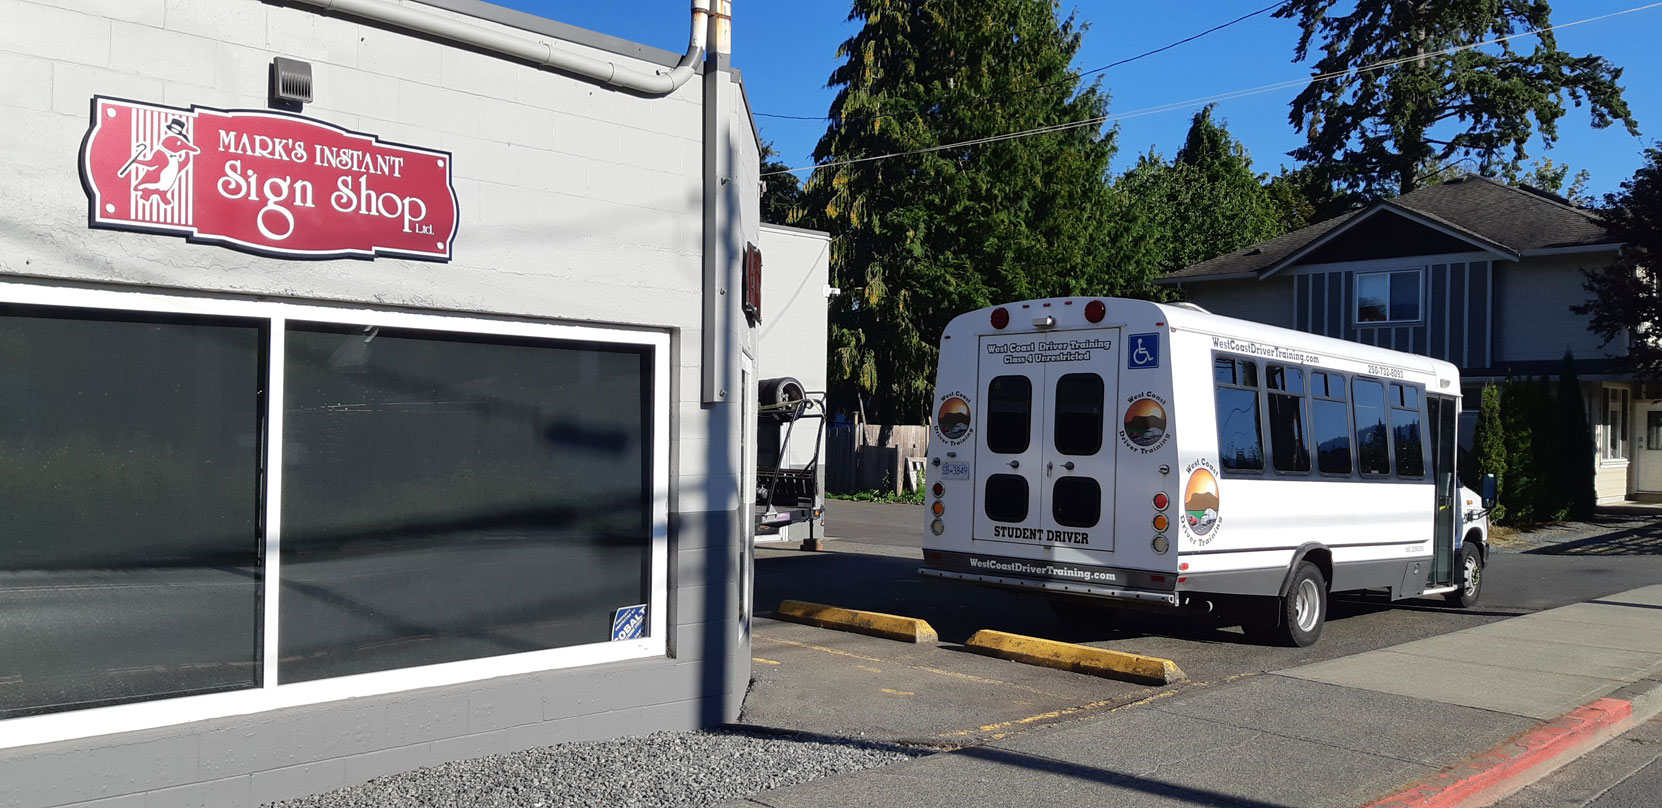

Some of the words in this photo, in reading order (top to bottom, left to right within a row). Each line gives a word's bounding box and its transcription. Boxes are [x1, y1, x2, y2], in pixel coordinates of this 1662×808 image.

[218, 129, 307, 163] MARK'S
[314, 144, 404, 178] INSTANT
[217, 159, 315, 240] Sign
[330, 174, 427, 233] Shop
[415, 223, 435, 236] Ltd.
[987, 343, 1008, 354] West
[1009, 341, 1035, 353] Coast
[1038, 340, 1068, 351] Driver
[1069, 338, 1112, 350] Training
[1212, 336, 1320, 364] WestCoastDriverTraining.com
[1003, 354, 1026, 364] Class
[1026, 353, 1034, 363] 4
[1035, 351, 1091, 363] Unrestricted
[940, 391, 954, 402] West
[955, 391, 971, 404] Coast
[1127, 391, 1144, 403] West
[1146, 391, 1167, 405] Coast
[934, 425, 949, 445] Driver
[950, 427, 974, 447] Training
[1119, 430, 1139, 452] Driver
[1140, 433, 1171, 454] Training
[1185, 458, 1200, 475] West
[1201, 457, 1219, 478] Coast
[994, 525, 1044, 541] STUDENT
[1046, 529, 1089, 544] DRIVER
[1180, 514, 1197, 545] Driver
[1198, 516, 1223, 547] Training
[970, 558, 1116, 581] WestCoastDriverTraining.com
